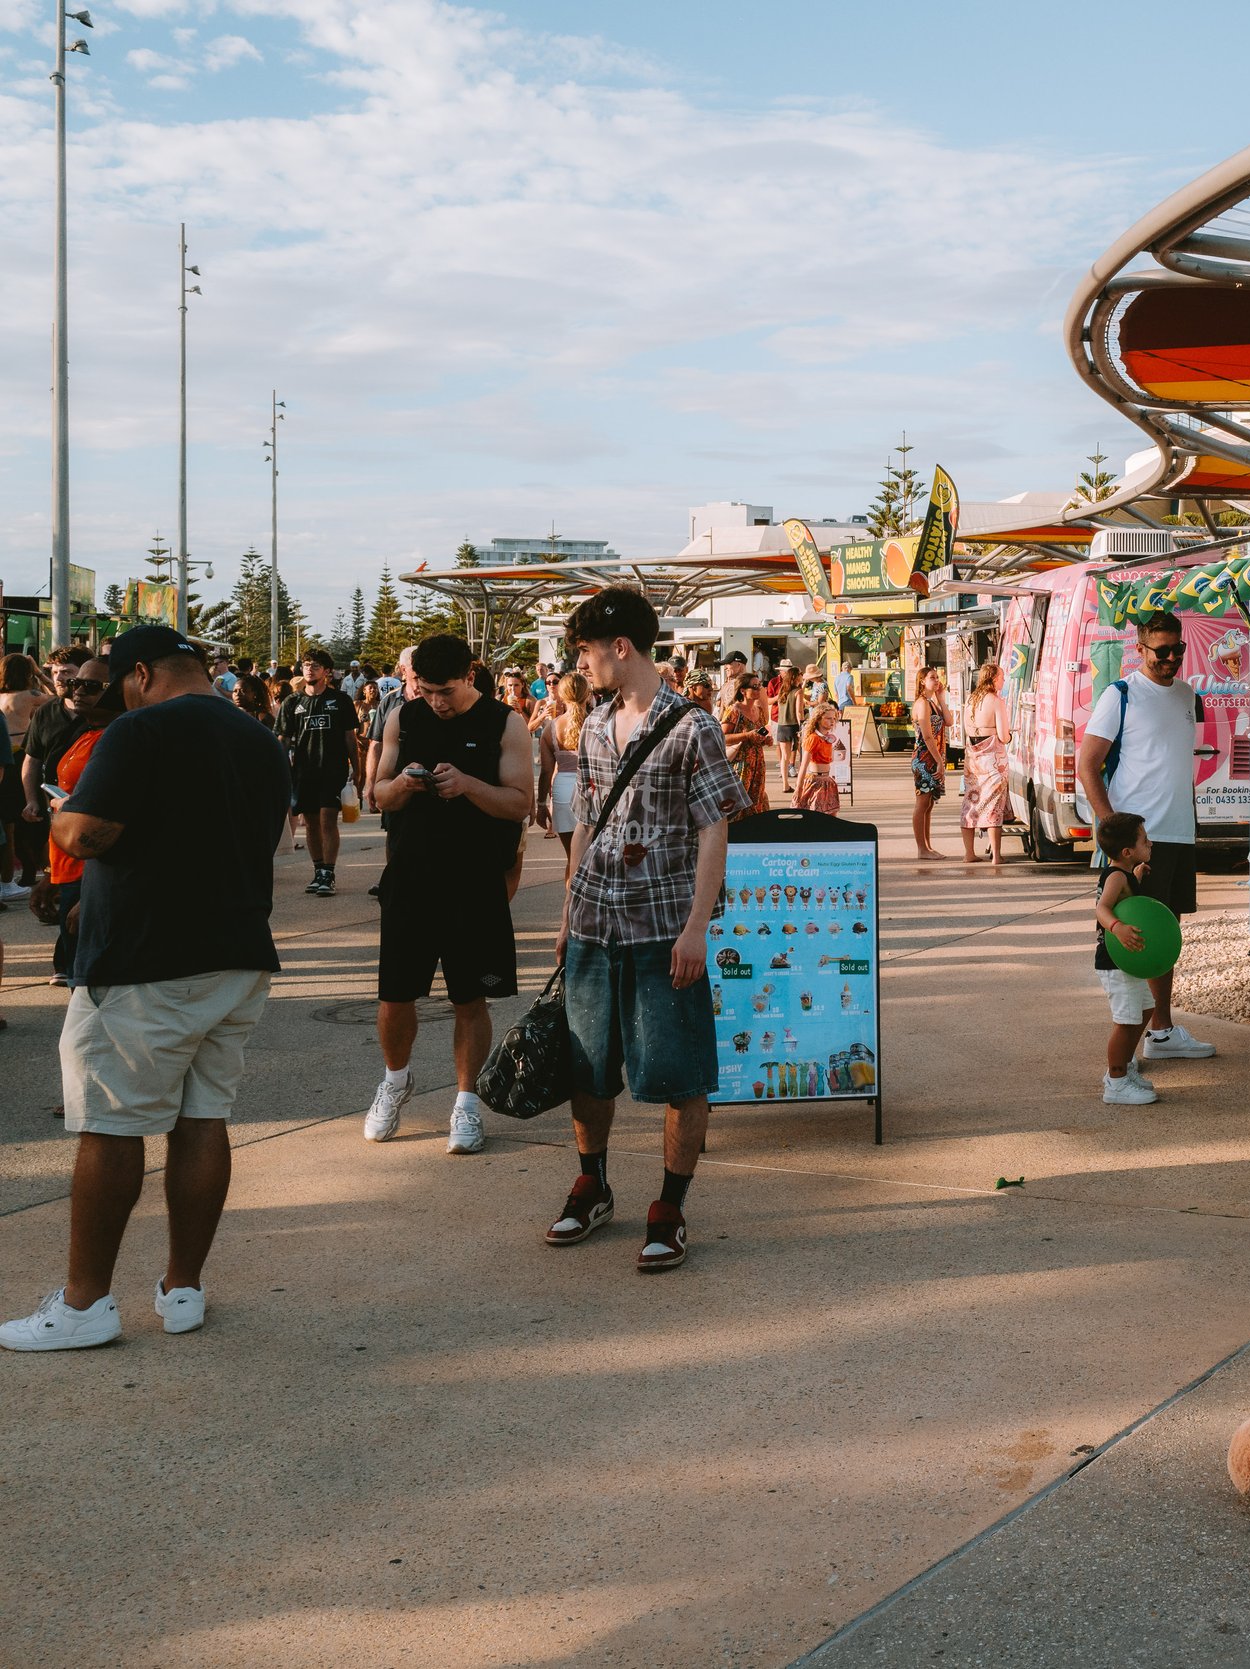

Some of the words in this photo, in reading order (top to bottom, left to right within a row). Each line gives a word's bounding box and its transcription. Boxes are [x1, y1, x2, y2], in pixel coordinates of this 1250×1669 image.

[845, 545, 873, 560] HEALTHY
[845, 561, 871, 575] MANGO
[846, 576, 880, 590] SMOOTHIE
[310, 717, 326, 727] AIG
[1196, 796, 1213, 804] Call:
[1215, 796, 1236, 804] 0435
[762, 857, 797, 867] Cartoon
[769, 868, 784, 877] Ice
[785, 866, 820, 878] Cream
[723, 967, 738, 976] Sold
[718, 1063, 743, 1074] USHY
